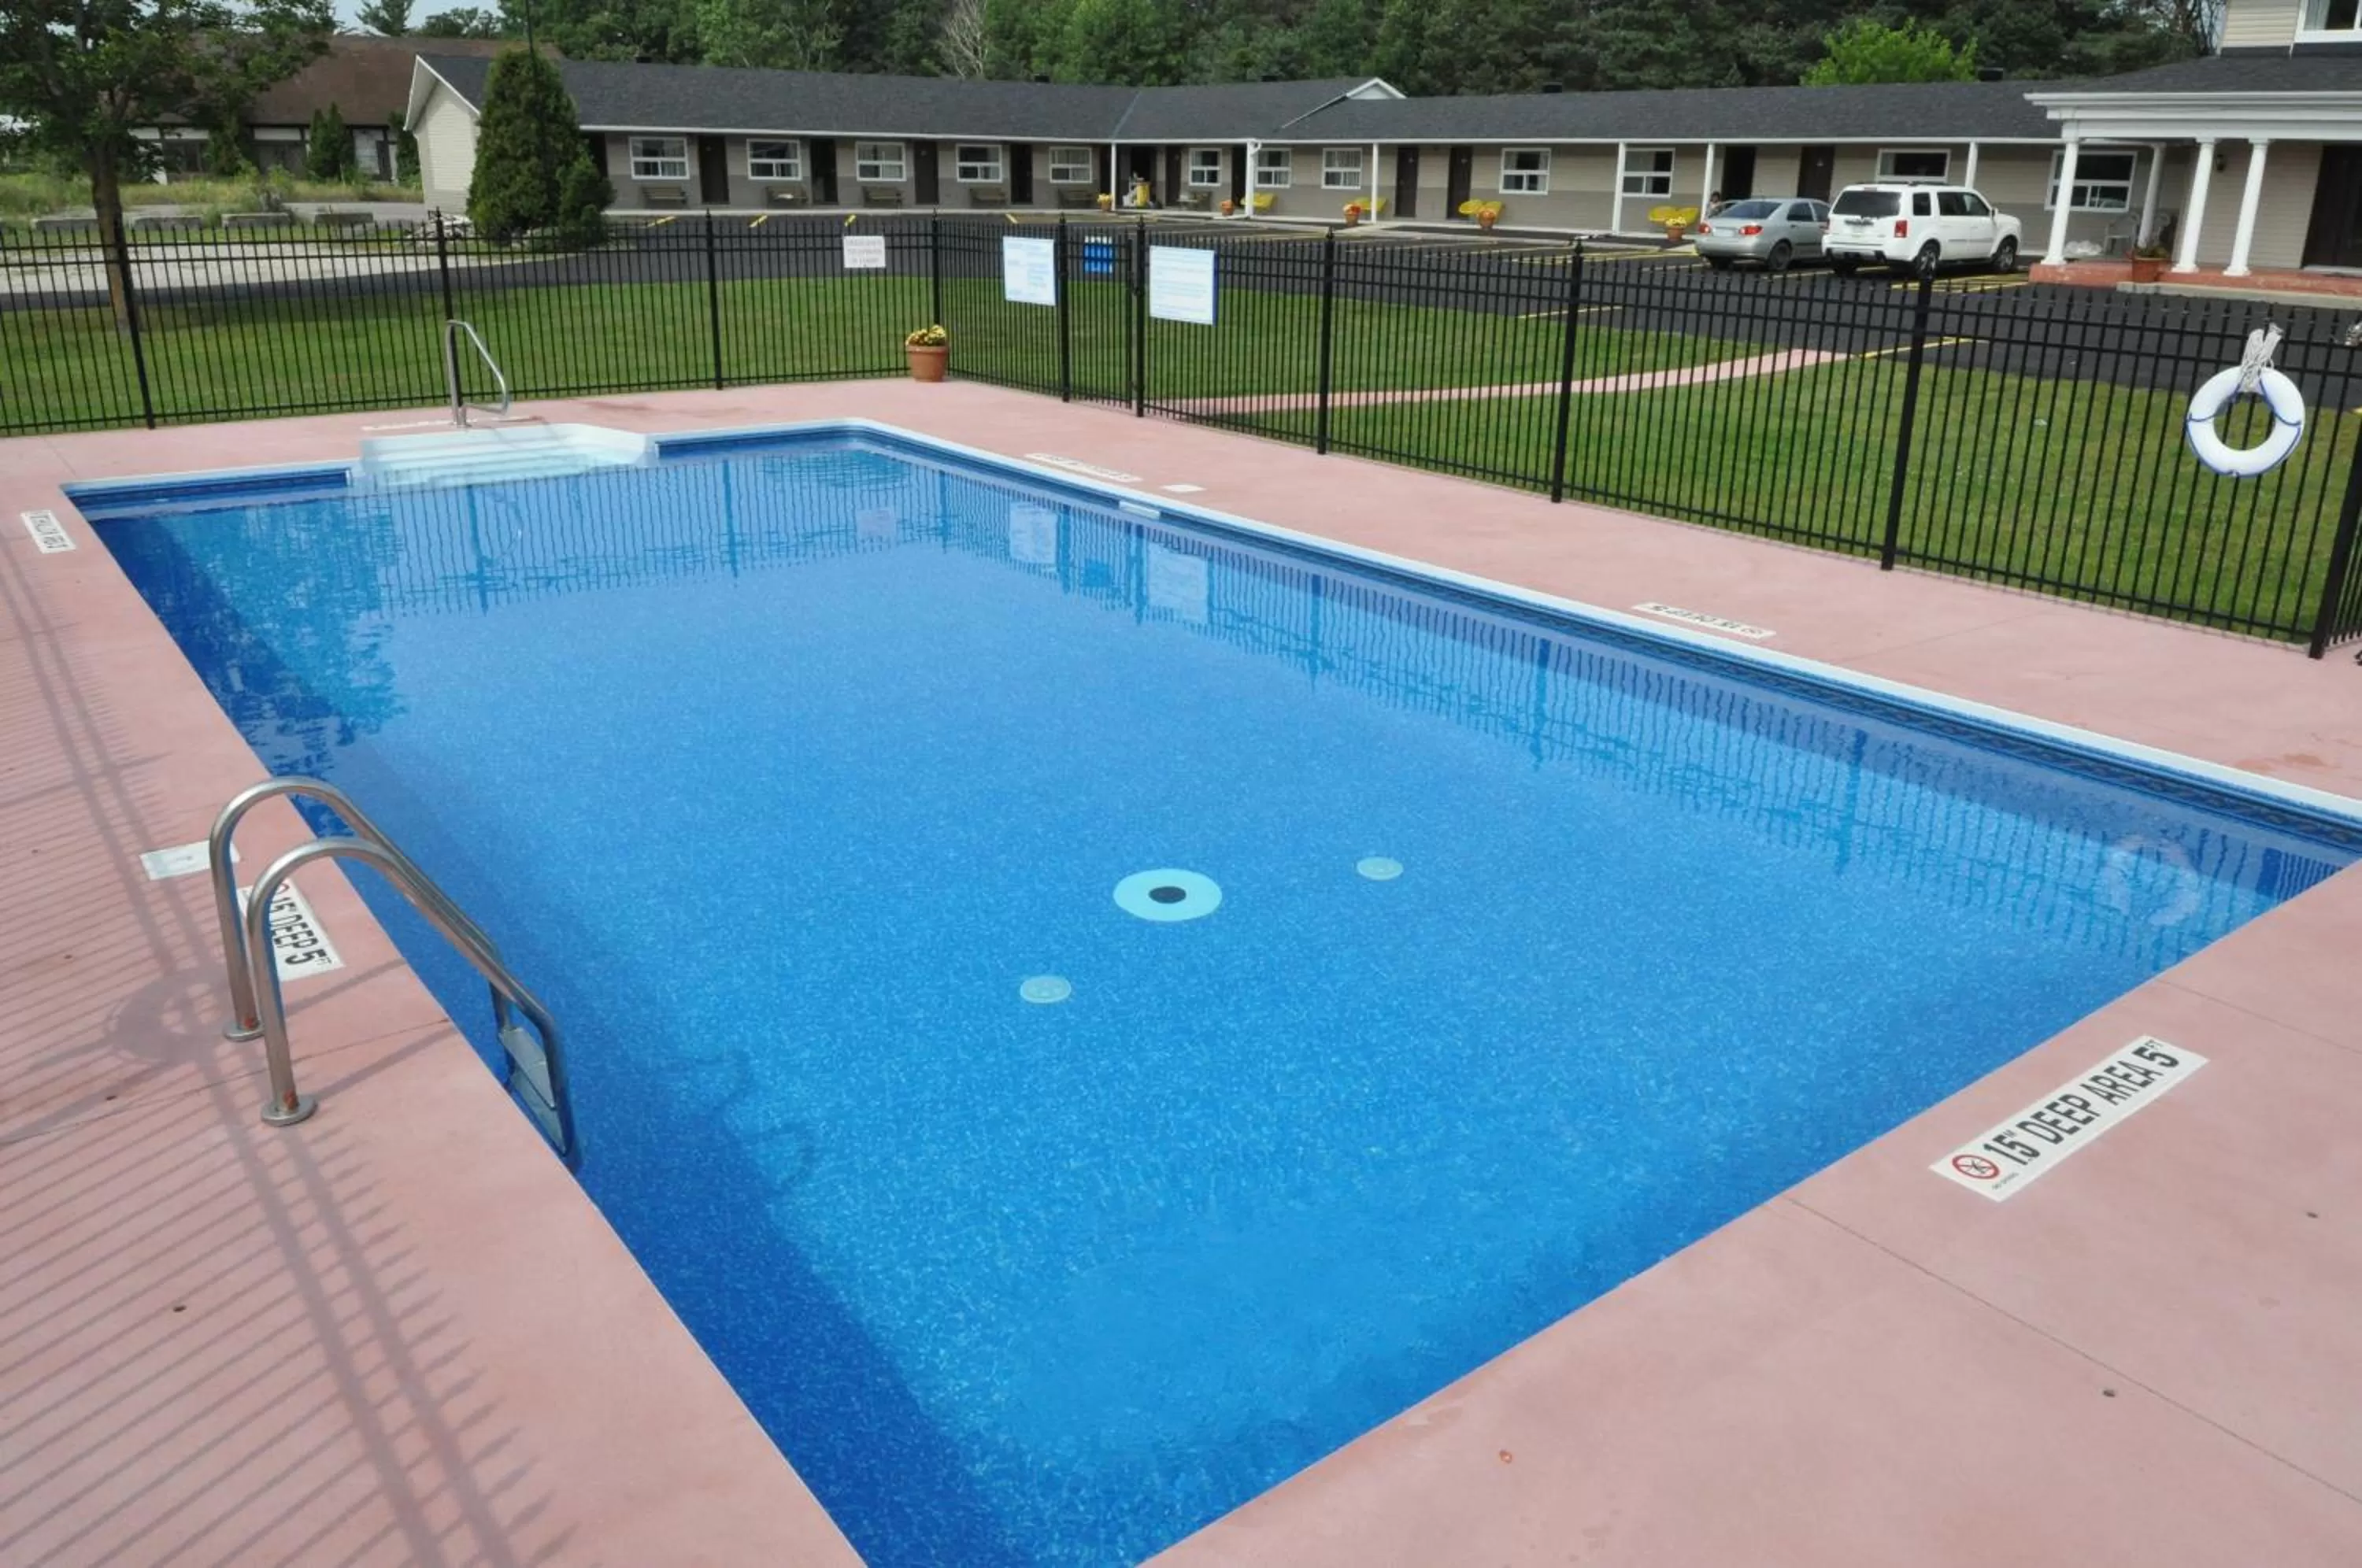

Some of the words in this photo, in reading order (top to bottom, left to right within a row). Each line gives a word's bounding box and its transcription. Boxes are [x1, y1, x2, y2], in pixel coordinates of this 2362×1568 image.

[270, 914, 319, 949] DEEP
[285, 949, 327, 965] 5
[2016, 1093, 2101, 1145] DEEP
[2079, 1060, 2164, 1106] AREA
[2131, 1045, 2179, 1068] 5
